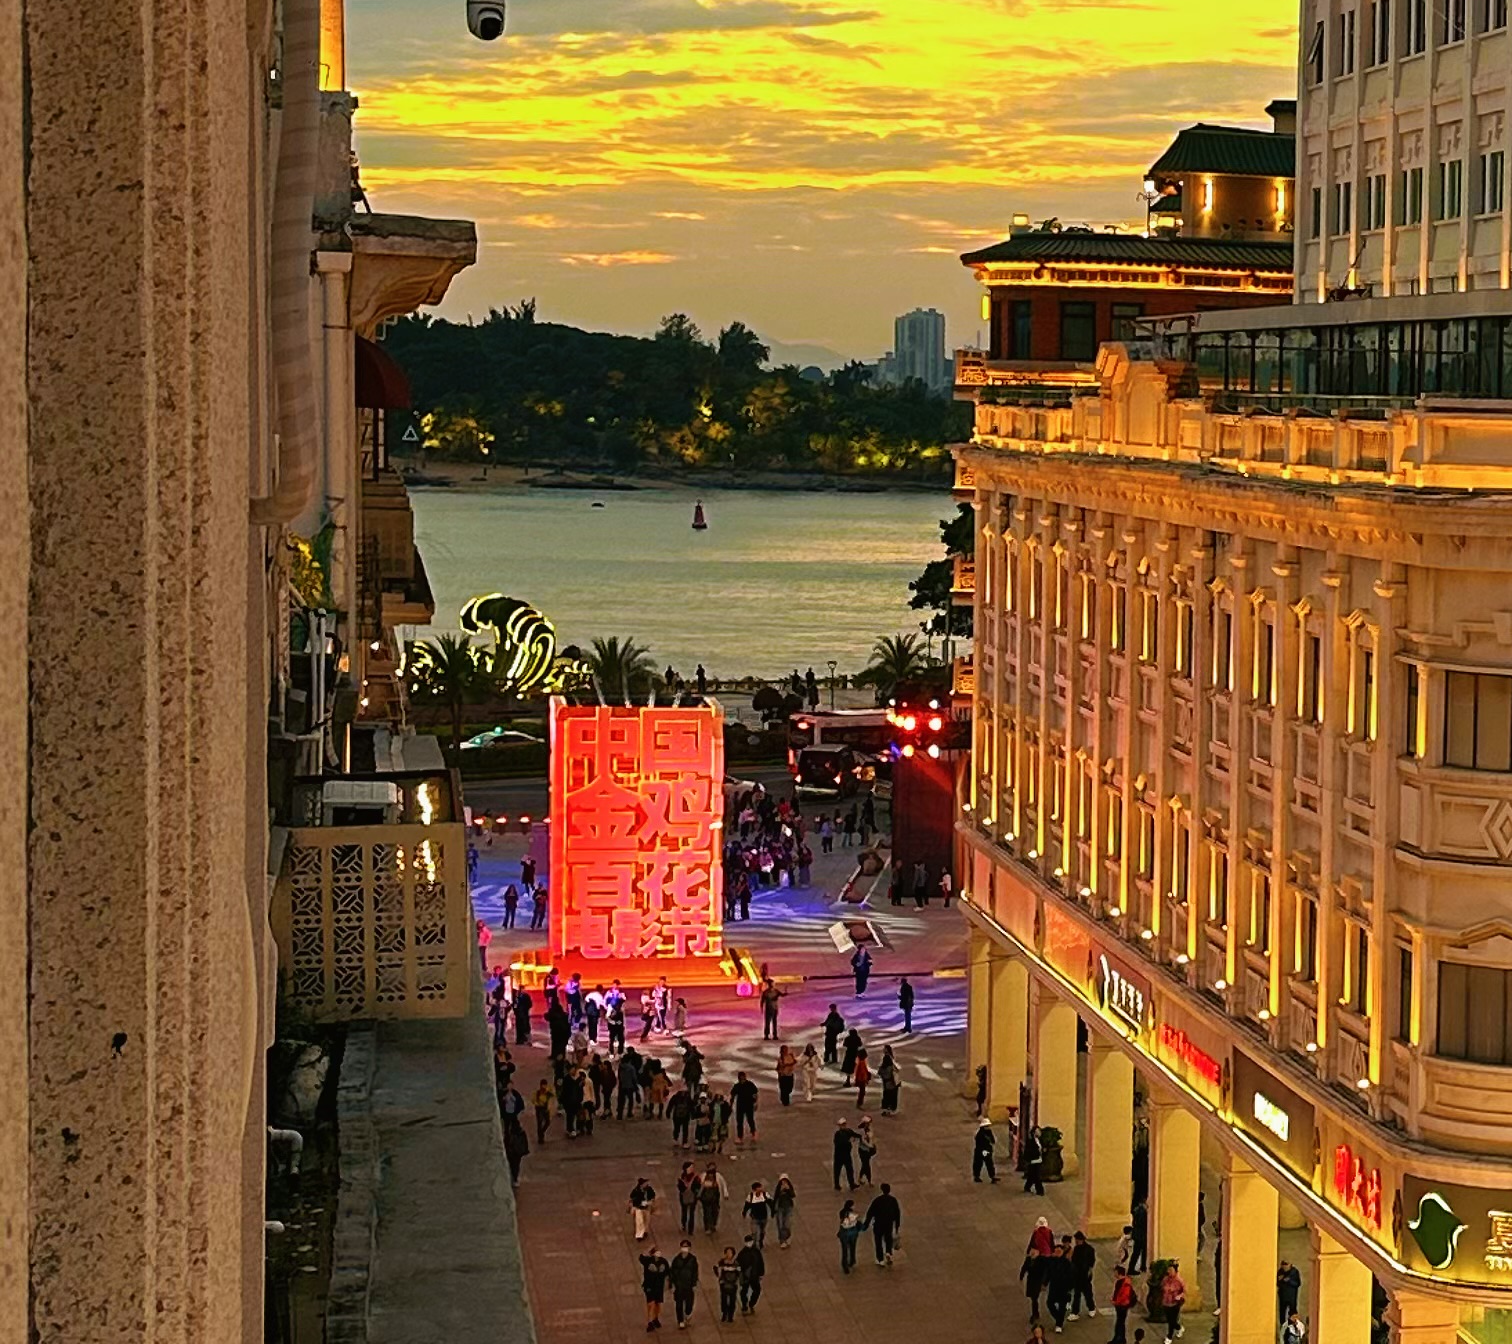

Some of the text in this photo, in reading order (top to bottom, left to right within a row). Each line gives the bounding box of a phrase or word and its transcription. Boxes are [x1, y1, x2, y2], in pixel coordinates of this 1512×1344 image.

[567, 706, 714, 775] 中国
[566, 773, 713, 850] 金鸡
[567, 846, 711, 914] 百花
[565, 909, 710, 959] 电影节
